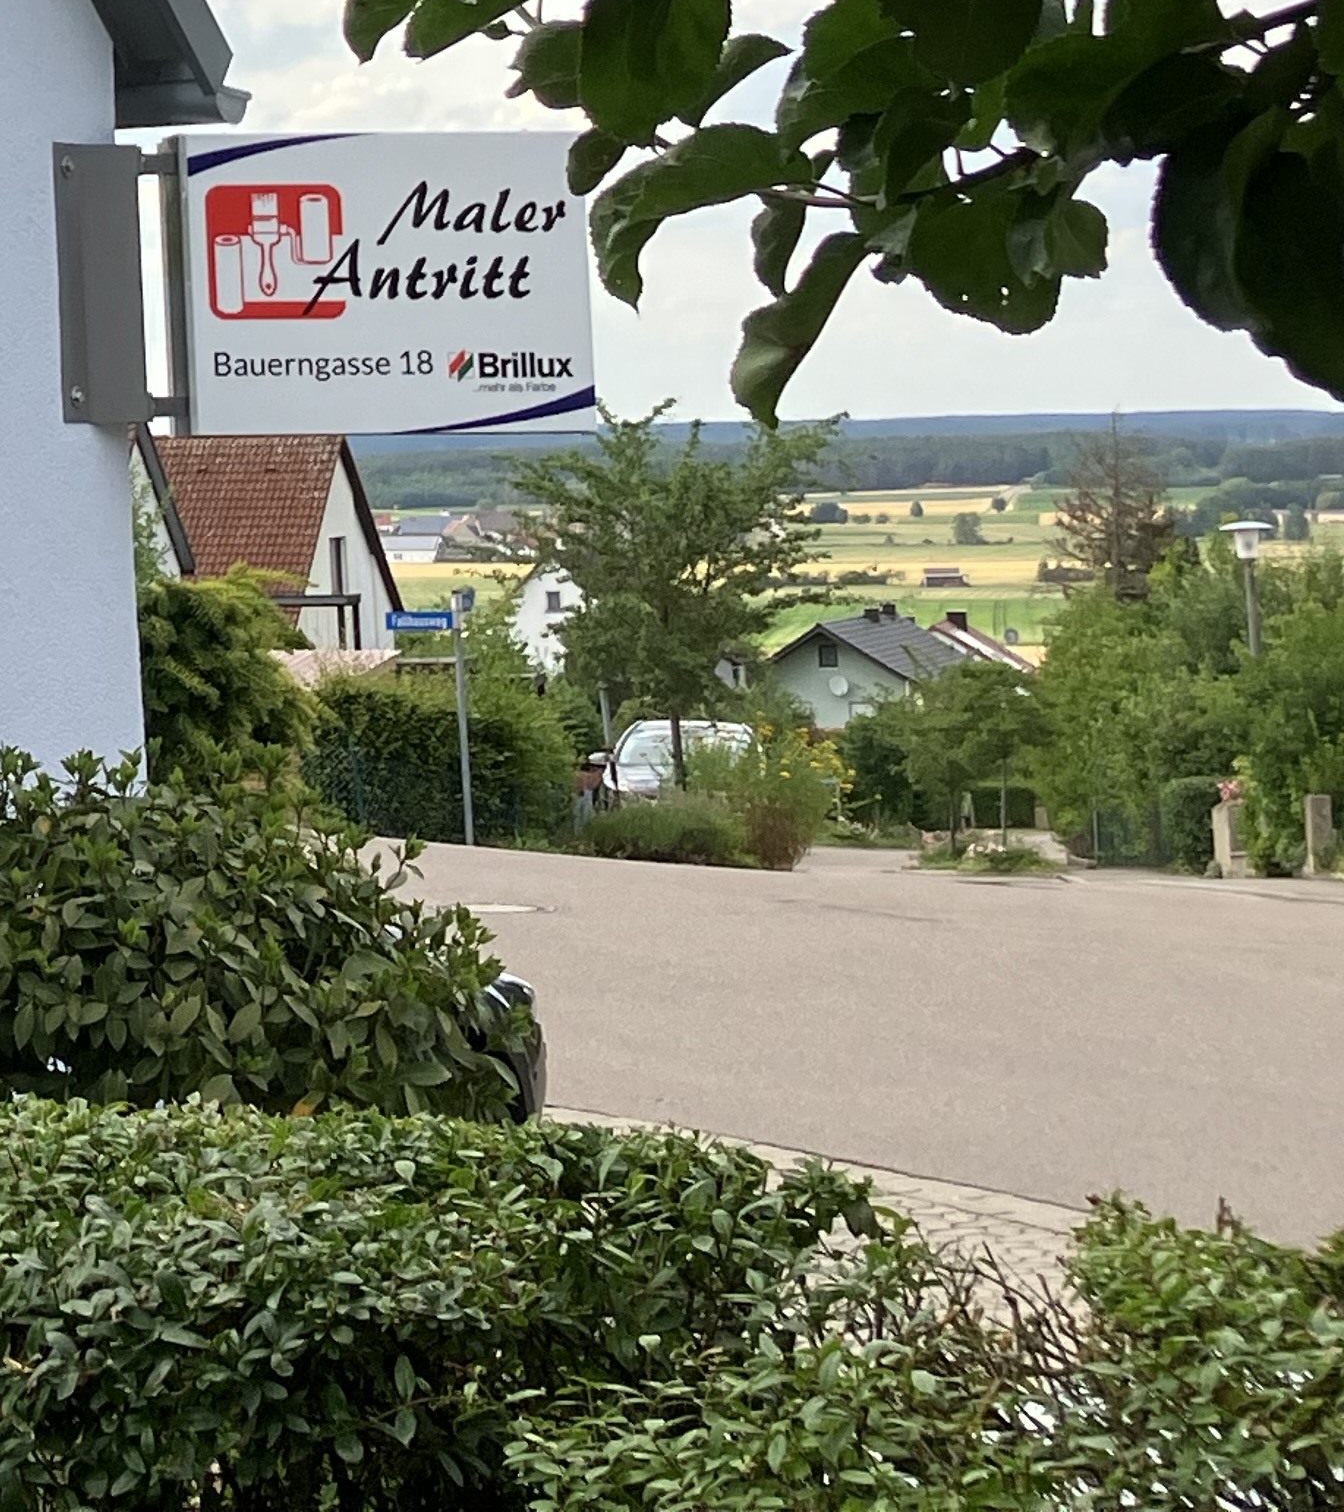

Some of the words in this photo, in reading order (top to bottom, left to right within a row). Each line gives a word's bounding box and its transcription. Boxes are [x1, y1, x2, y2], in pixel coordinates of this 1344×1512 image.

[377, 181, 566, 245] Maler
[302, 239, 531, 315] Antritt
[214, 352, 391, 382] Bauerngasse
[400, 350, 434, 376] 18
[478, 352, 574, 379] Brillux
